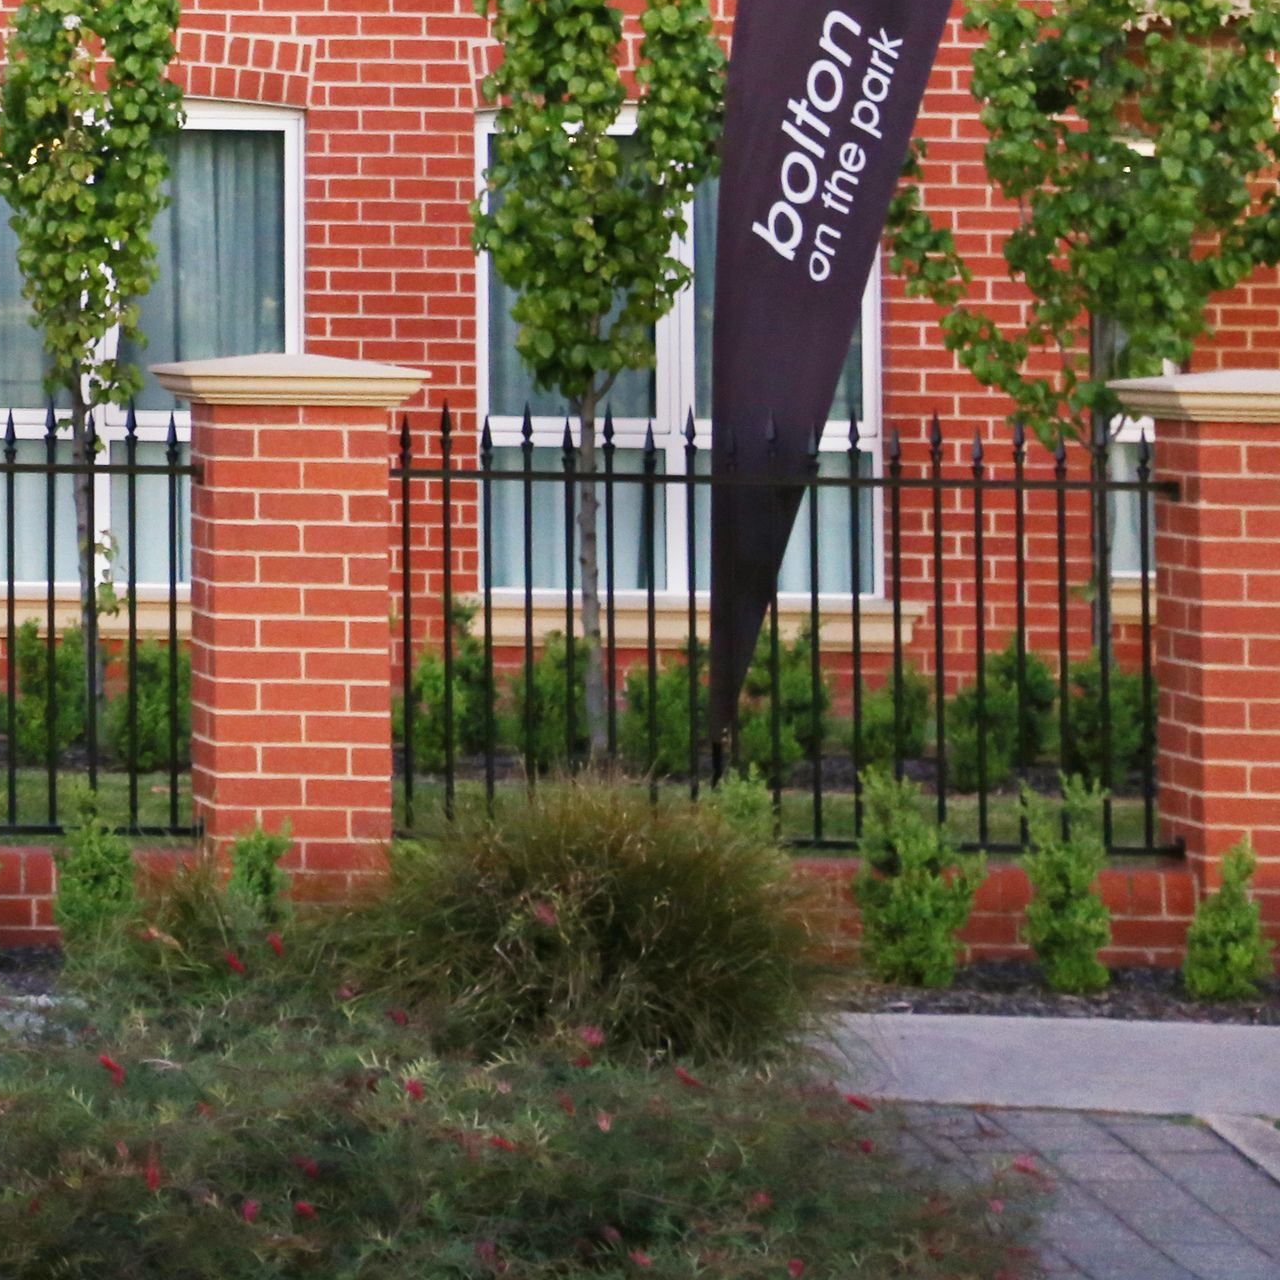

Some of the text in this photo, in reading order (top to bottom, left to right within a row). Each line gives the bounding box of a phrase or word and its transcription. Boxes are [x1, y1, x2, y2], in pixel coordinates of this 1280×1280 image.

[751, 10, 862, 261] bolton
[809, 27, 904, 282] on the park
